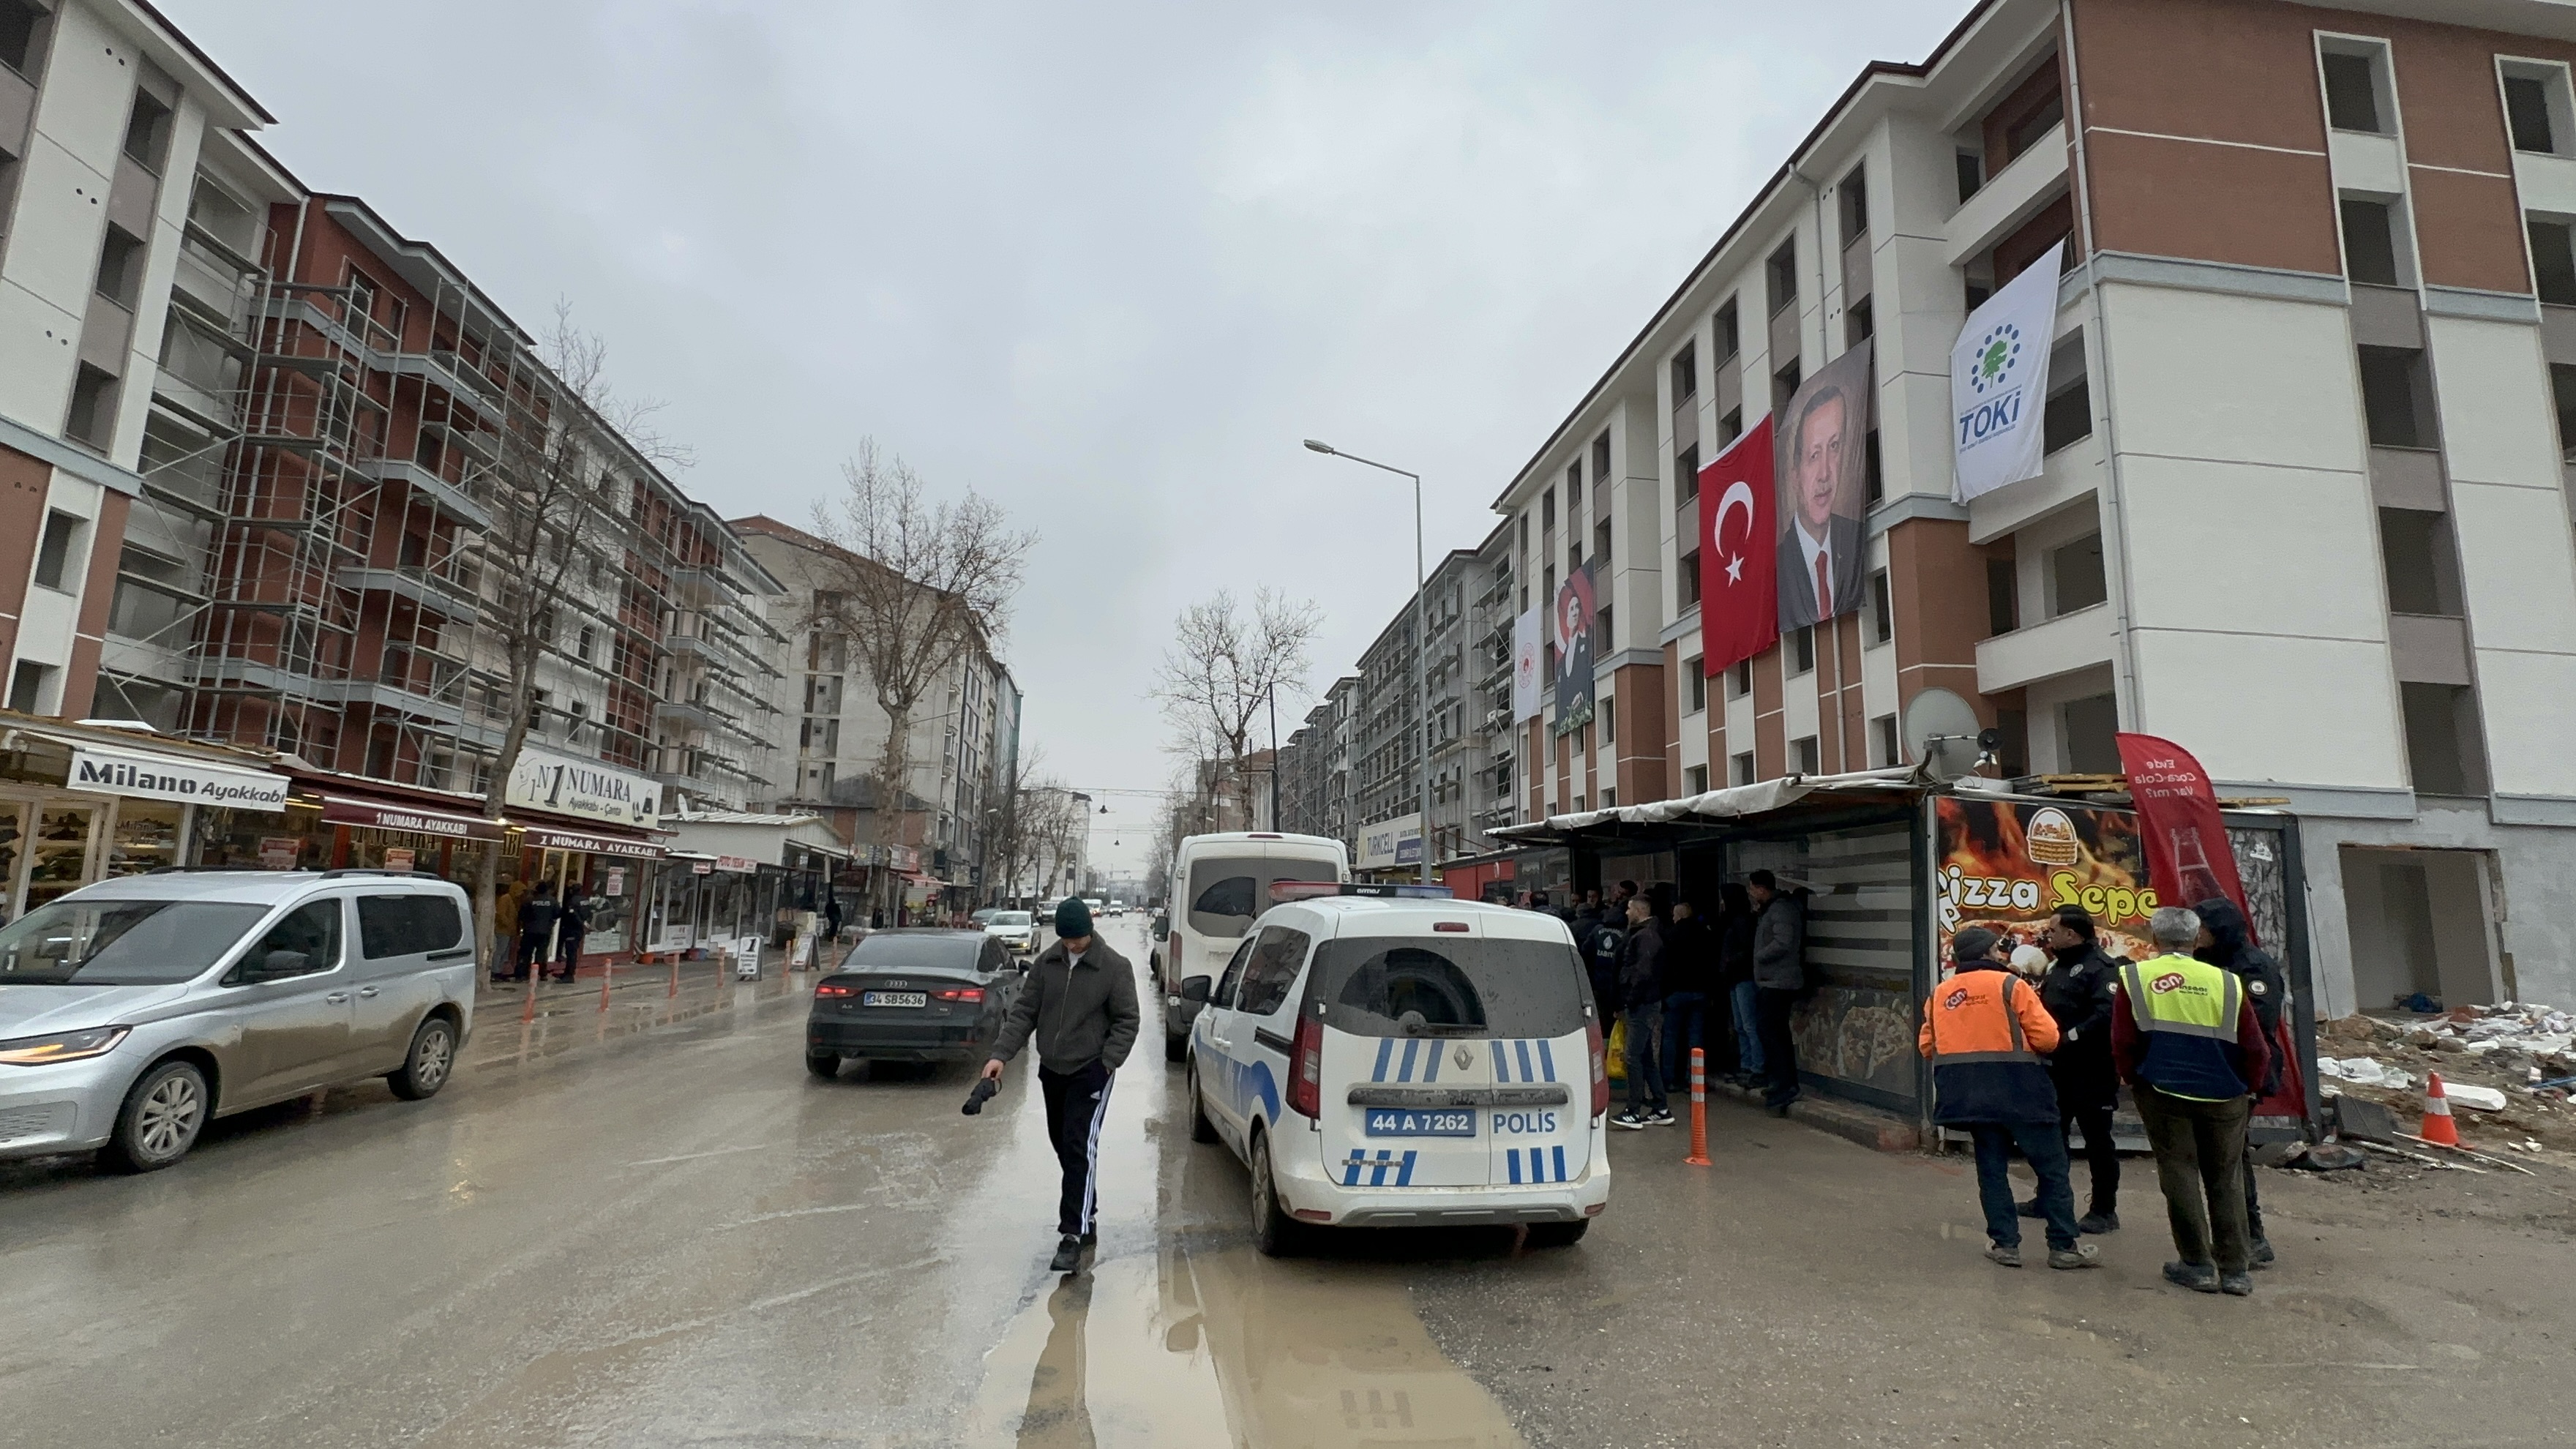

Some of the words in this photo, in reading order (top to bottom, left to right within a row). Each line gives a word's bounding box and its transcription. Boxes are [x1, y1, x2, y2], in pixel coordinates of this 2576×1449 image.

[79, 760, 198, 795] Milano
[201, 781, 286, 804] Ayakkabı
[566, 766, 631, 803] NUMARA
[376, 812, 381, 825] 1
[382, 813, 423, 830] NUMARA
[424, 818, 468, 836] AYAKKABI
[539, 835, 547, 845] 1
[551, 836, 601, 851] NUMARA
[607, 842, 658, 857] AYAKKABI
[746, 938, 757, 952] 1
[869, 995, 883, 1005] 34
[1372, 1115, 1397, 1130] 44
[1402, 1115, 1417, 1131] A
[1422, 1115, 1469, 1131] 7262
[1493, 1108, 1557, 1134] POLİS
